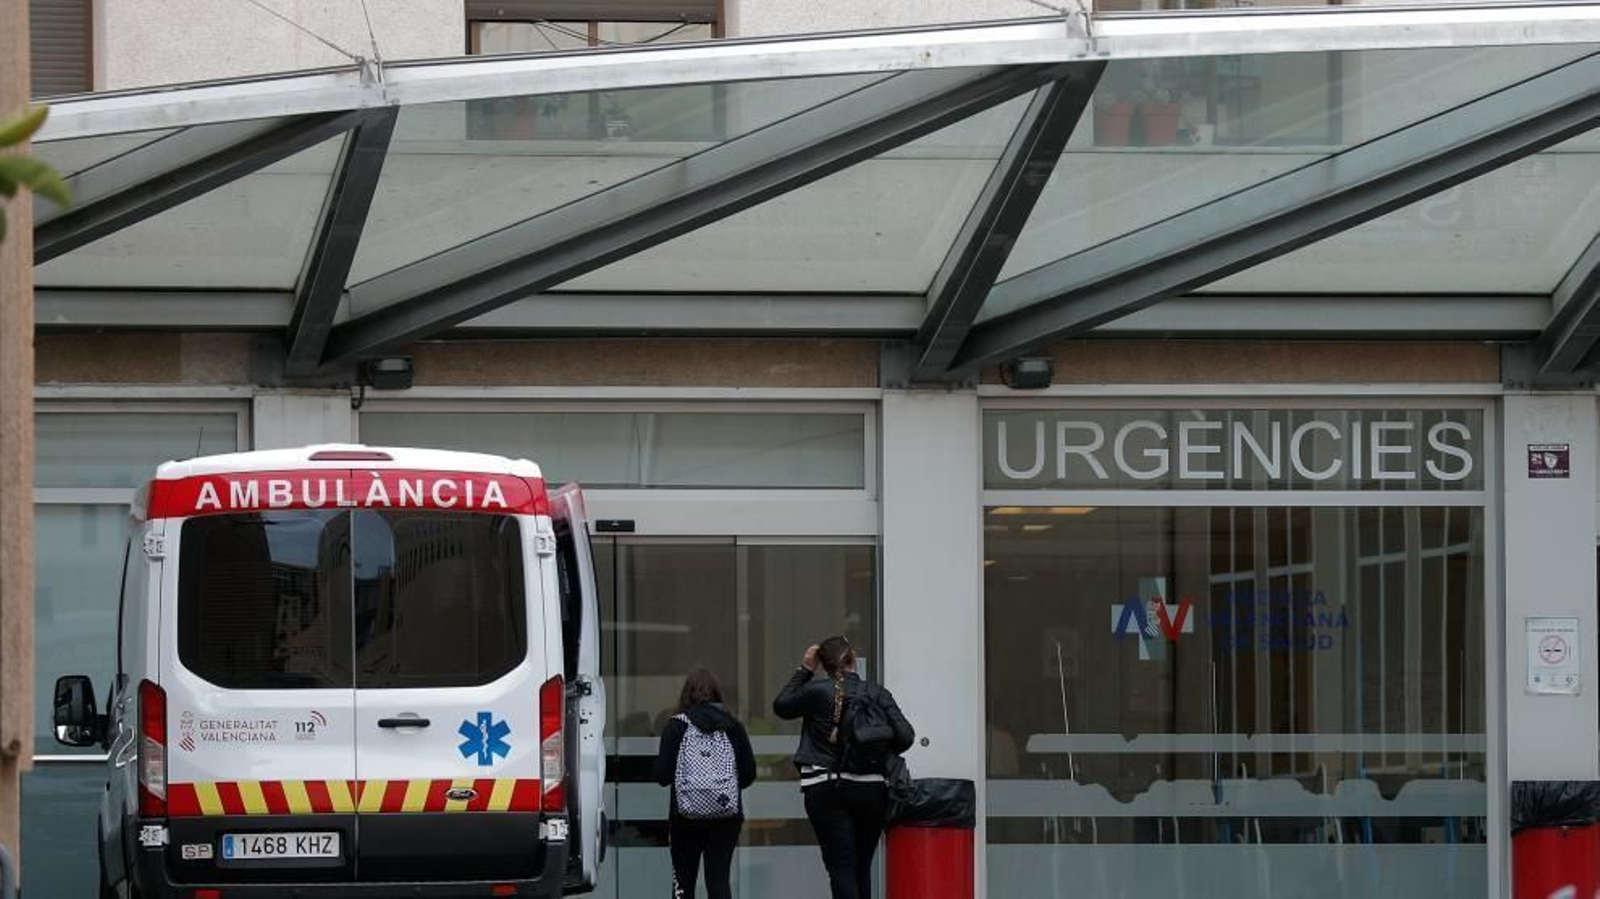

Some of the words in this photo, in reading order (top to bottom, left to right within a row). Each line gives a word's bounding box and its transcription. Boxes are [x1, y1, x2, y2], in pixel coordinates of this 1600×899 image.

[998, 411, 1474, 480] URGÈNCIES
[194, 471, 508, 509] AMBULÀNCIA
[199, 720, 278, 730] GENERALITAT
[295, 721, 315, 733] 112
[200, 732, 277, 742] VALENCIANA
[184, 845, 210, 858] SP
[240, 836, 288, 855] 1468
[296, 835, 332, 854] KHZ
